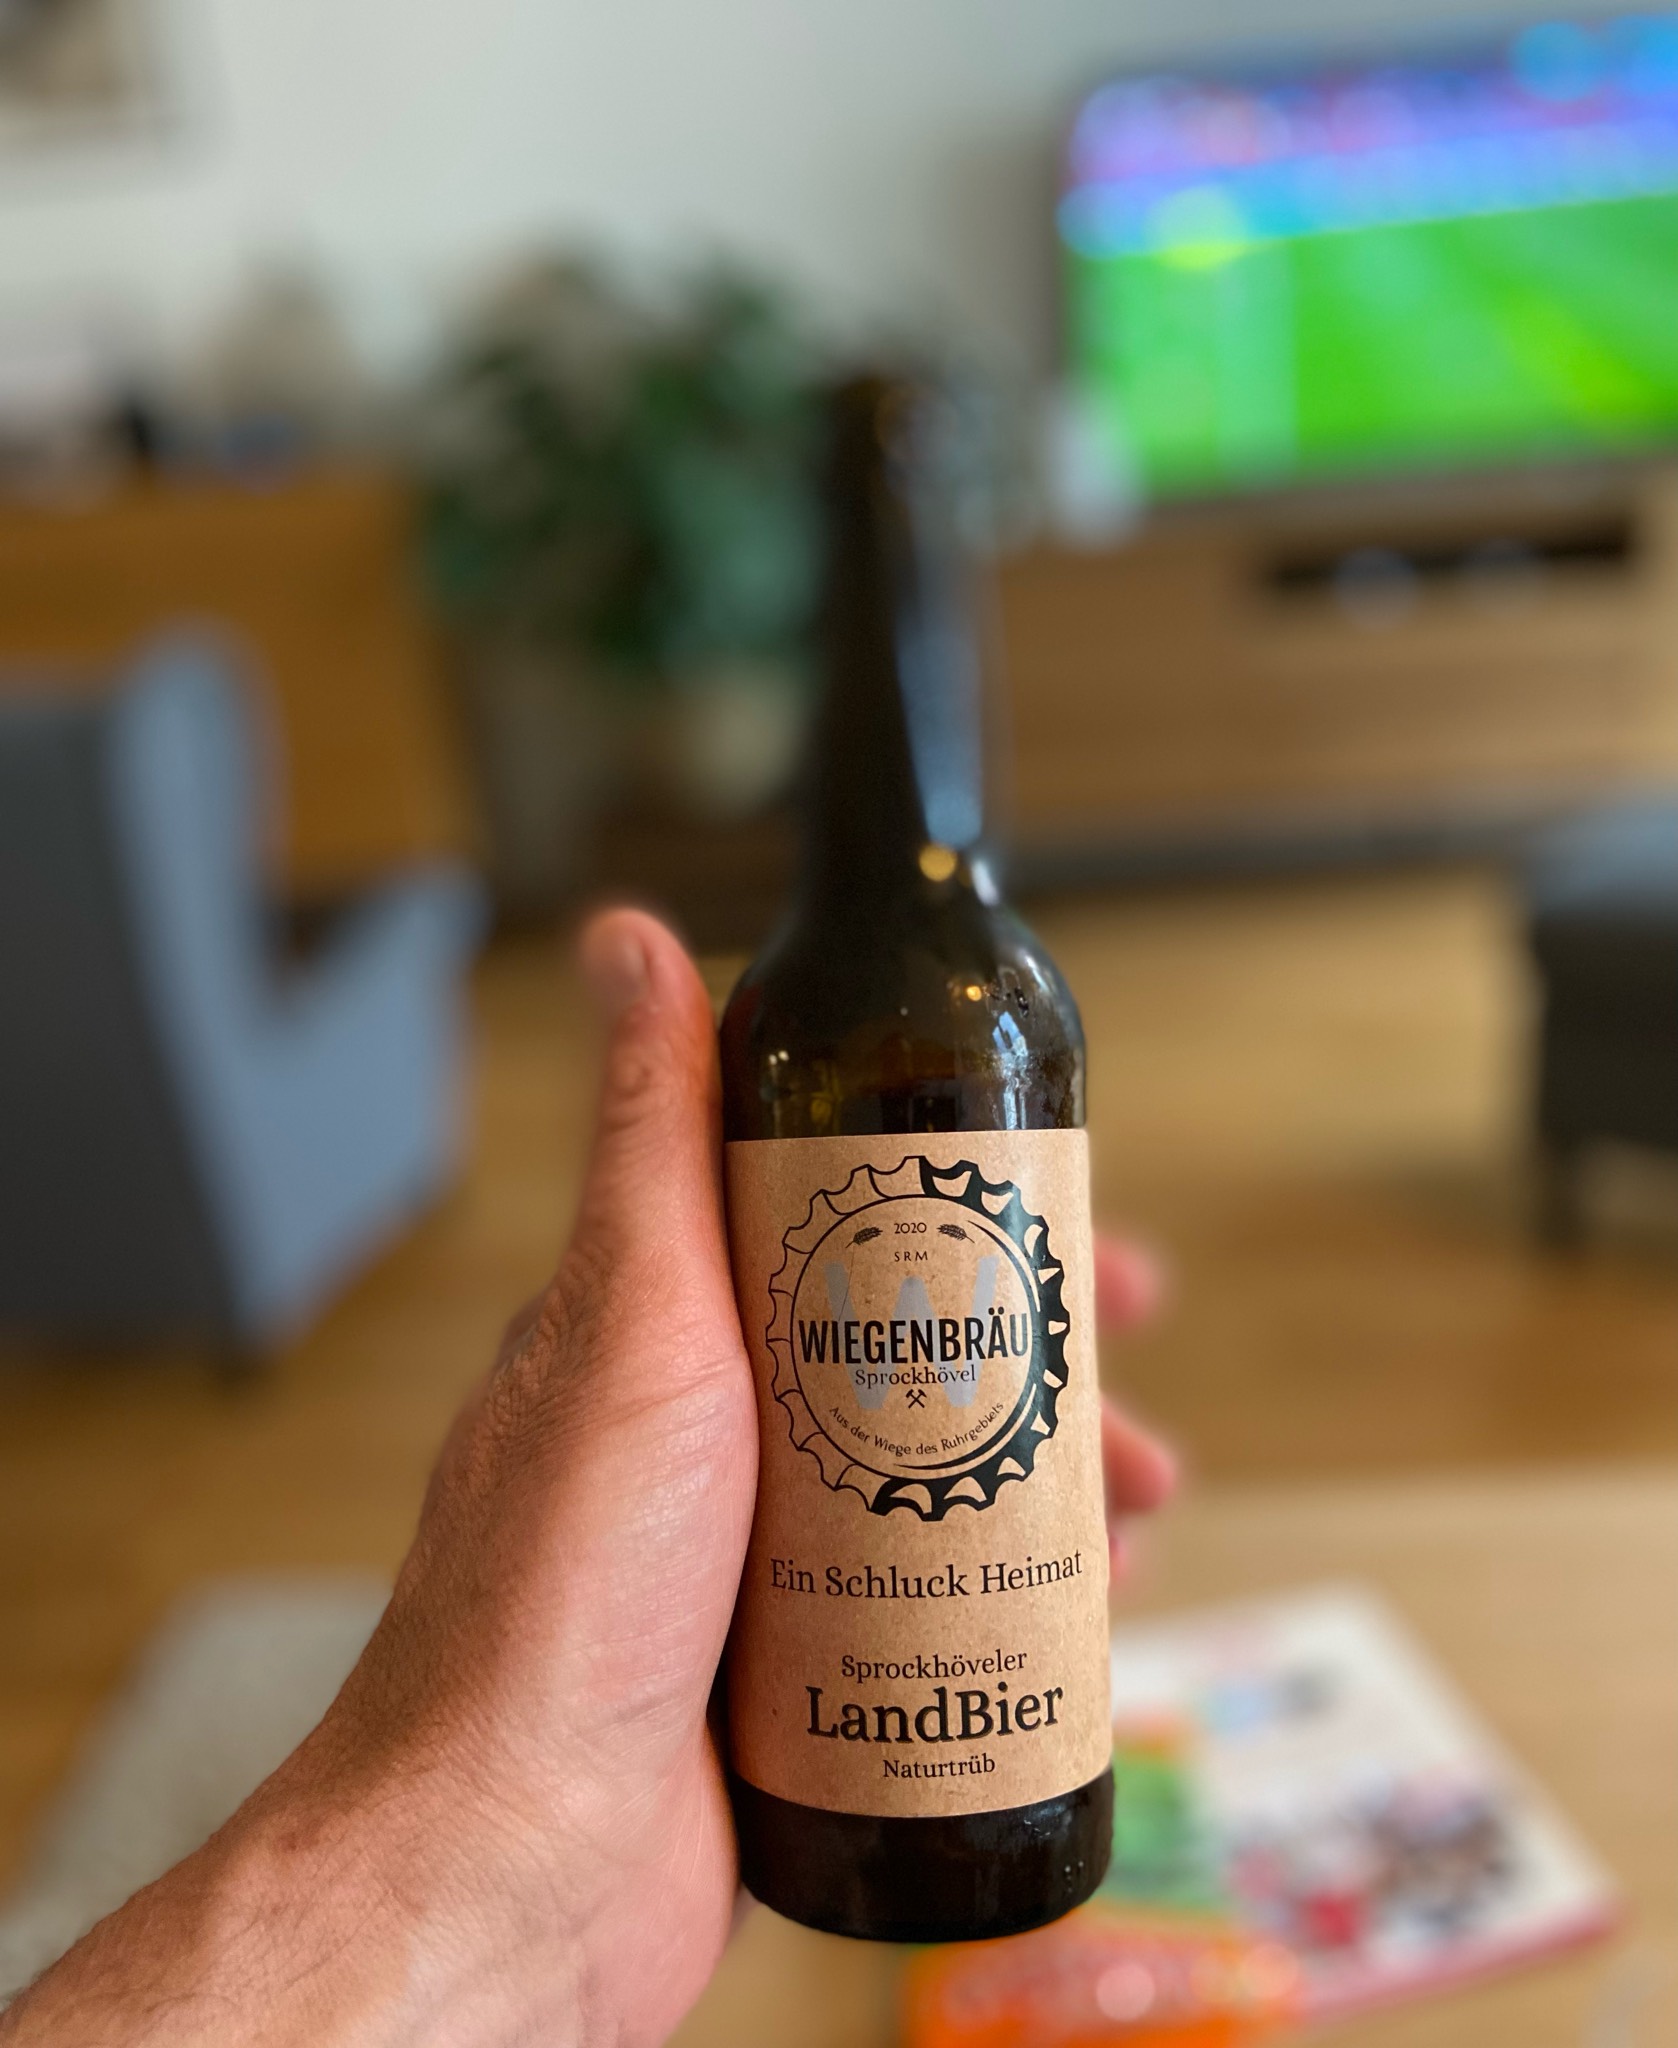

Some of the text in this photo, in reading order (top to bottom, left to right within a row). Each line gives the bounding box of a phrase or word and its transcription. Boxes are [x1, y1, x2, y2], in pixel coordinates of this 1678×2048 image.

[894, 1222, 927, 1235] 2020
[799, 1306, 1028, 1364] WIEGENBRÄU
[855, 1365, 976, 1390] Sprockhövel
[829, 1400, 1004, 1457] Aus der Wiege des Ruhrgebiets
[770, 1549, 1083, 1599] Ein Schluck Heimat
[841, 1649, 1028, 1684] Sprockhöveler
[805, 1681, 1063, 1744] LandBier
[883, 1754, 996, 1778] Naturtrüb
